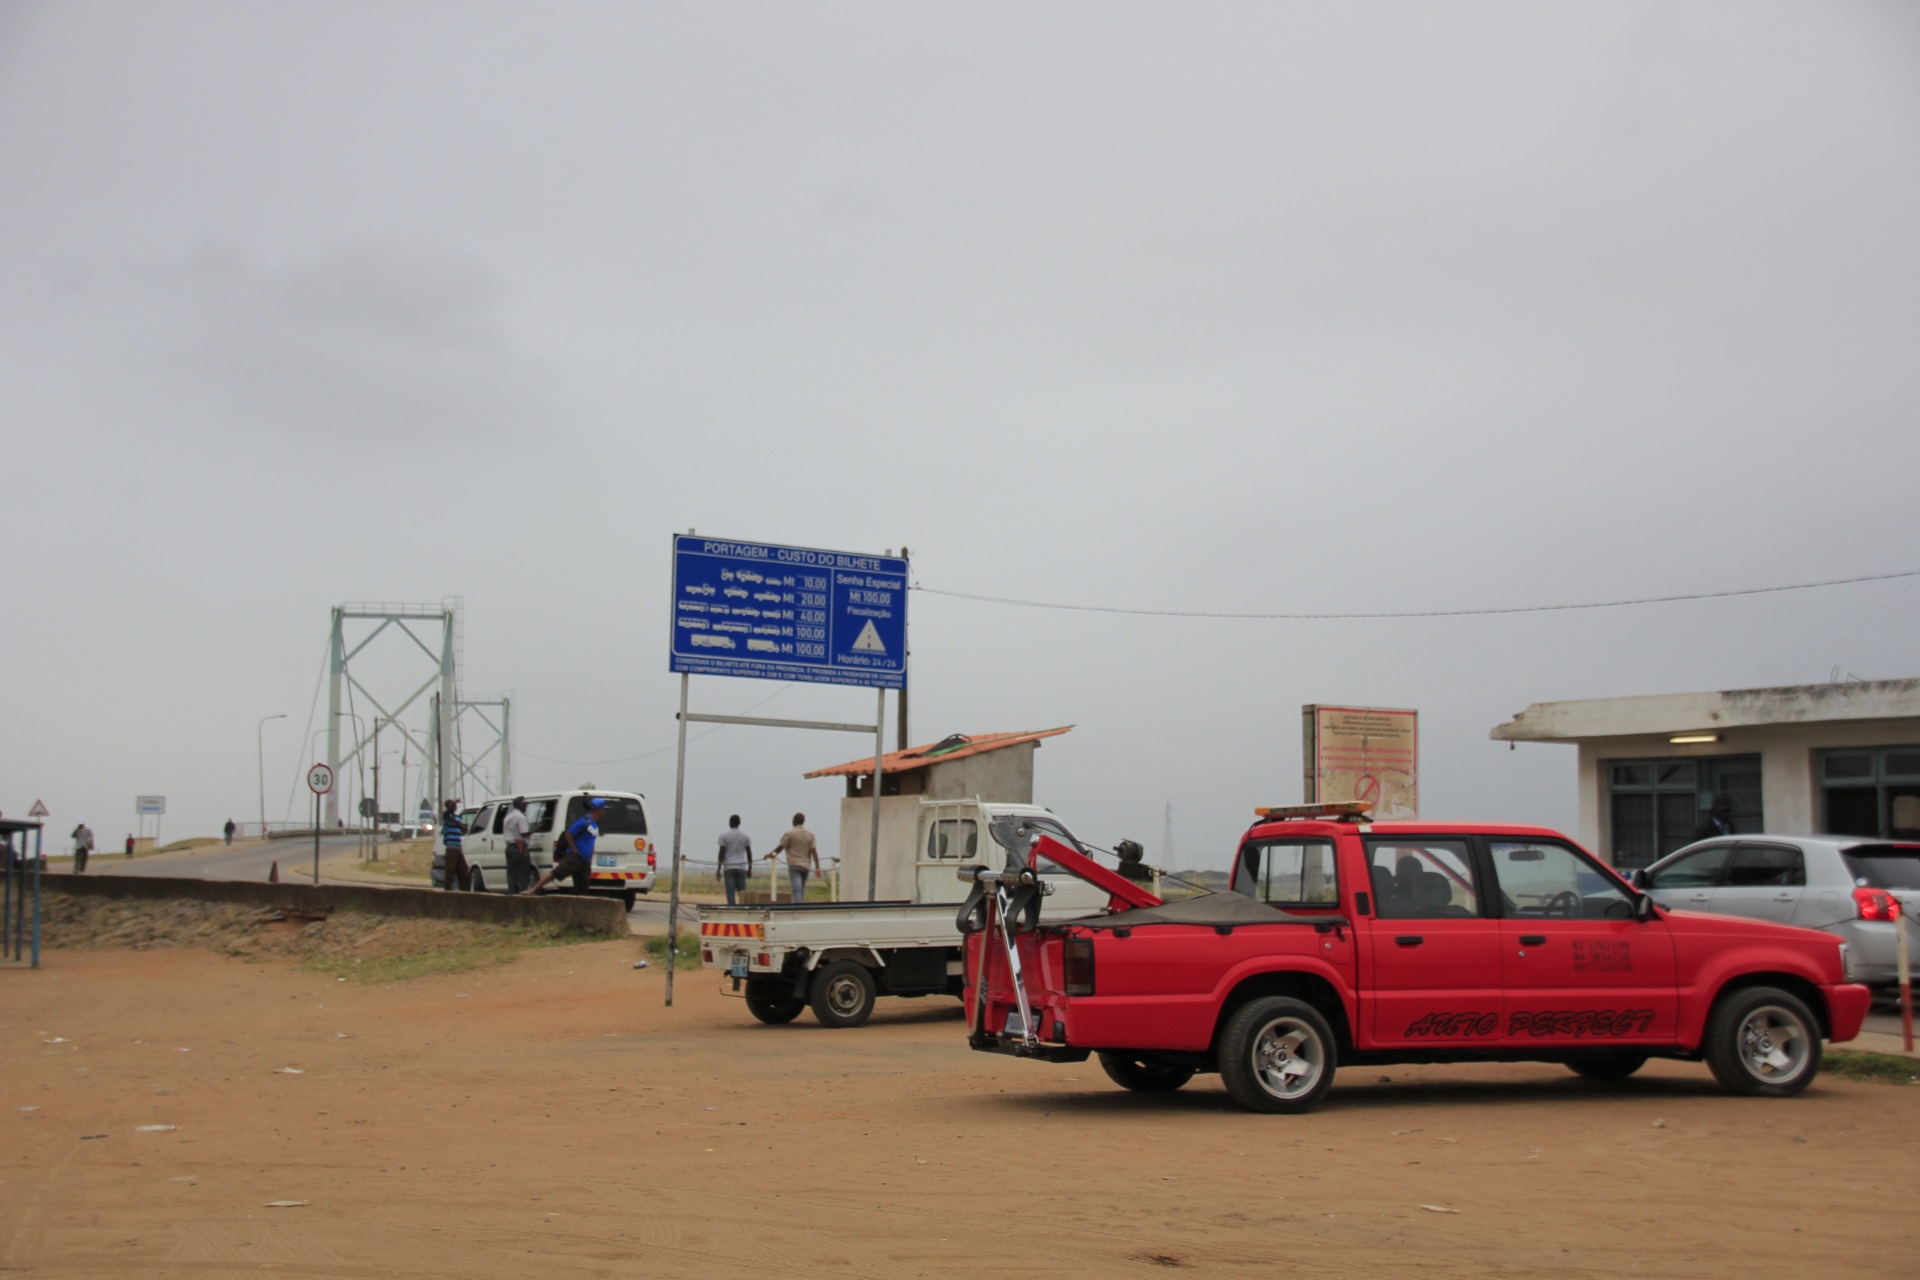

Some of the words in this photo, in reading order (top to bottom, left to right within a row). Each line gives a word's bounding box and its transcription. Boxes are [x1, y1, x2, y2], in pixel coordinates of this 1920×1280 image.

[704, 542, 768, 558] PORTAGEM
[778, 550, 816, 563] CUSTO
[818, 554, 834, 565] DO
[837, 556, 880, 570] BILHETE
[784, 576, 795, 587] Mt
[804, 578, 826, 589] 10.00
[837, 574, 864, 586] Senha
[866, 577, 901, 590] Especial
[783, 593, 794, 603] Mt
[801, 594, 826, 606] 20.00
[850, 592, 861, 601] Mt
[863, 592, 891, 604] 100.00
[782, 610, 794, 620] Mt
[801, 611, 826, 623] 40.00
[782, 626, 793, 637] Mt
[797, 628, 825, 639] 100.00
[781, 643, 793, 654] Mt
[797, 644, 825, 656] 100.00
[872, 658, 896, 668] 24/24
[314, 774, 328, 785] 30
[1404, 1011, 1498, 1037] AUTO
[1508, 1009, 1655, 1038] PERFECT
